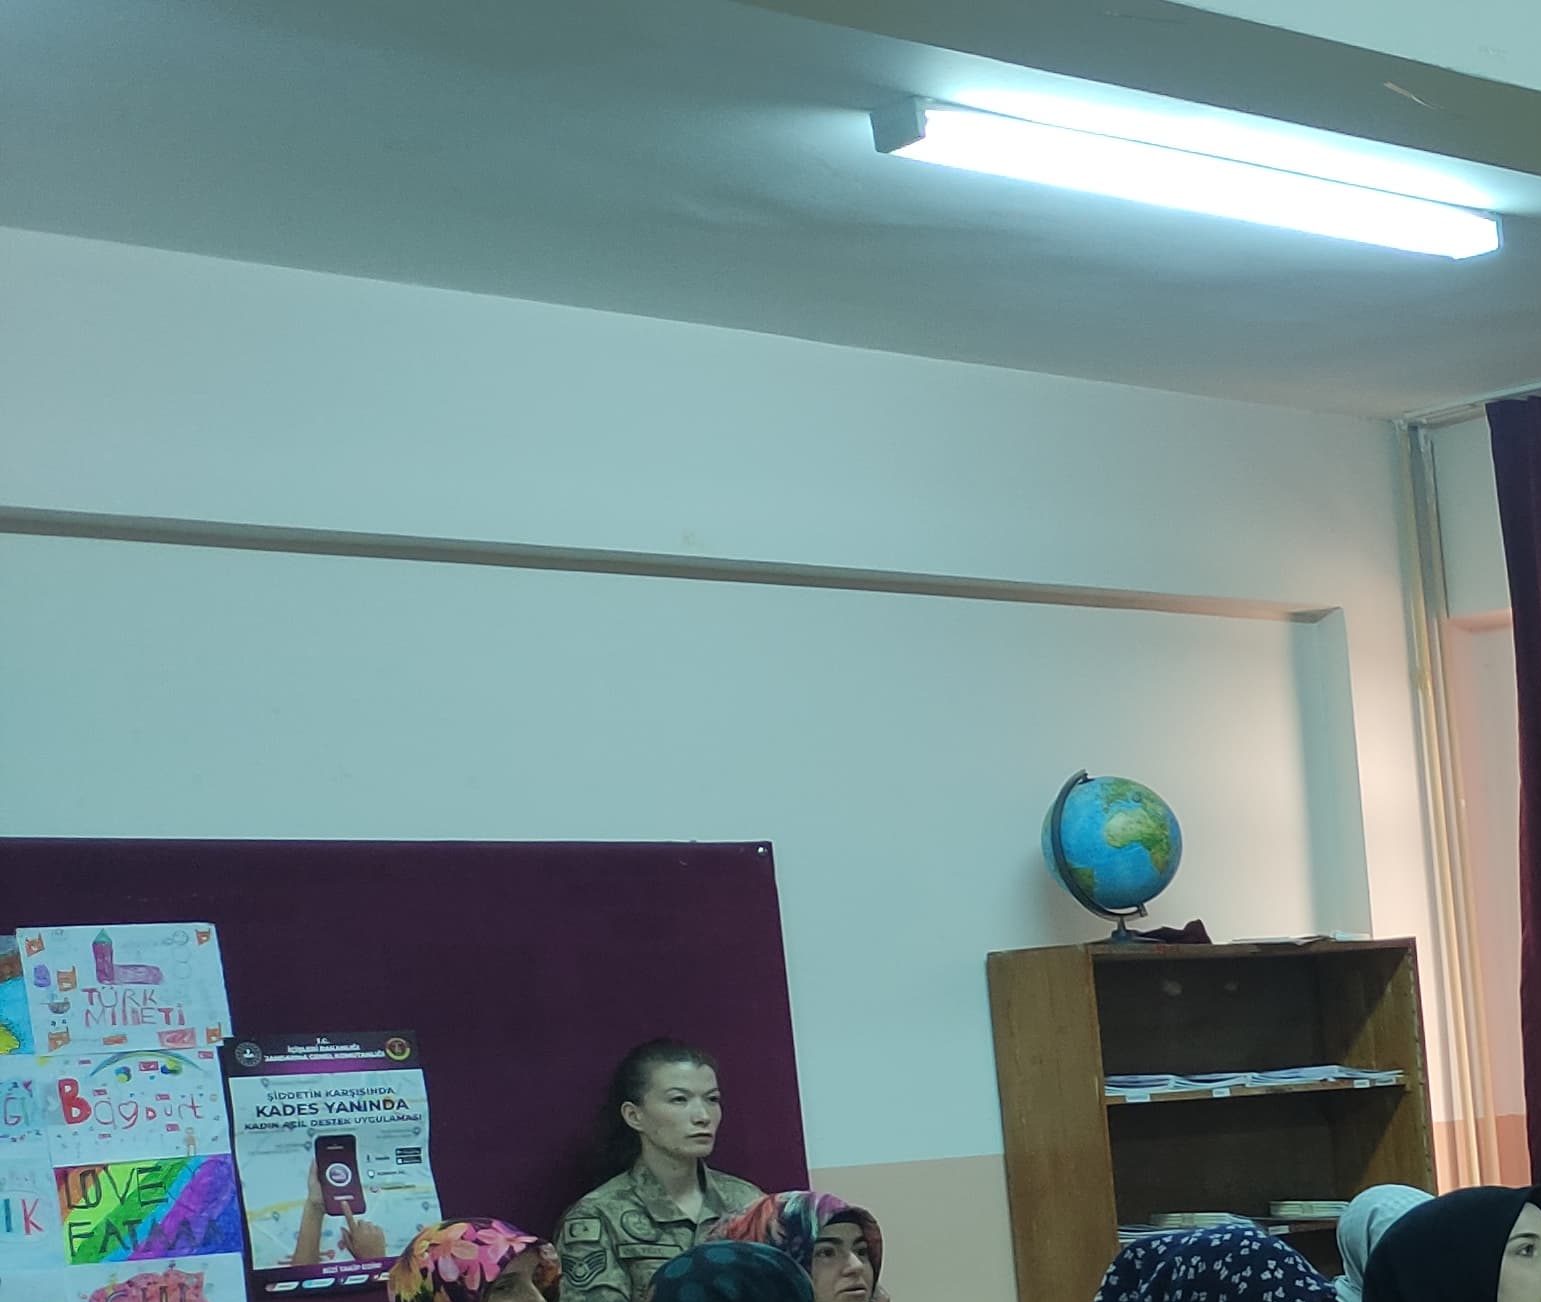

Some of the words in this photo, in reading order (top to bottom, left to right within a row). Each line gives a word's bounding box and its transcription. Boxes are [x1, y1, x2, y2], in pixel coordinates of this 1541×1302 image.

[82, 986, 158, 1008] TÜRK
[267, 1088, 322, 1102] ŞİDDETİN
[325, 1086, 396, 1099] KARŞISINDA
[256, 1102, 319, 1118] KADES
[324, 1098, 409, 1114] YANINDA
[65, 1164, 169, 1211] LOVE
